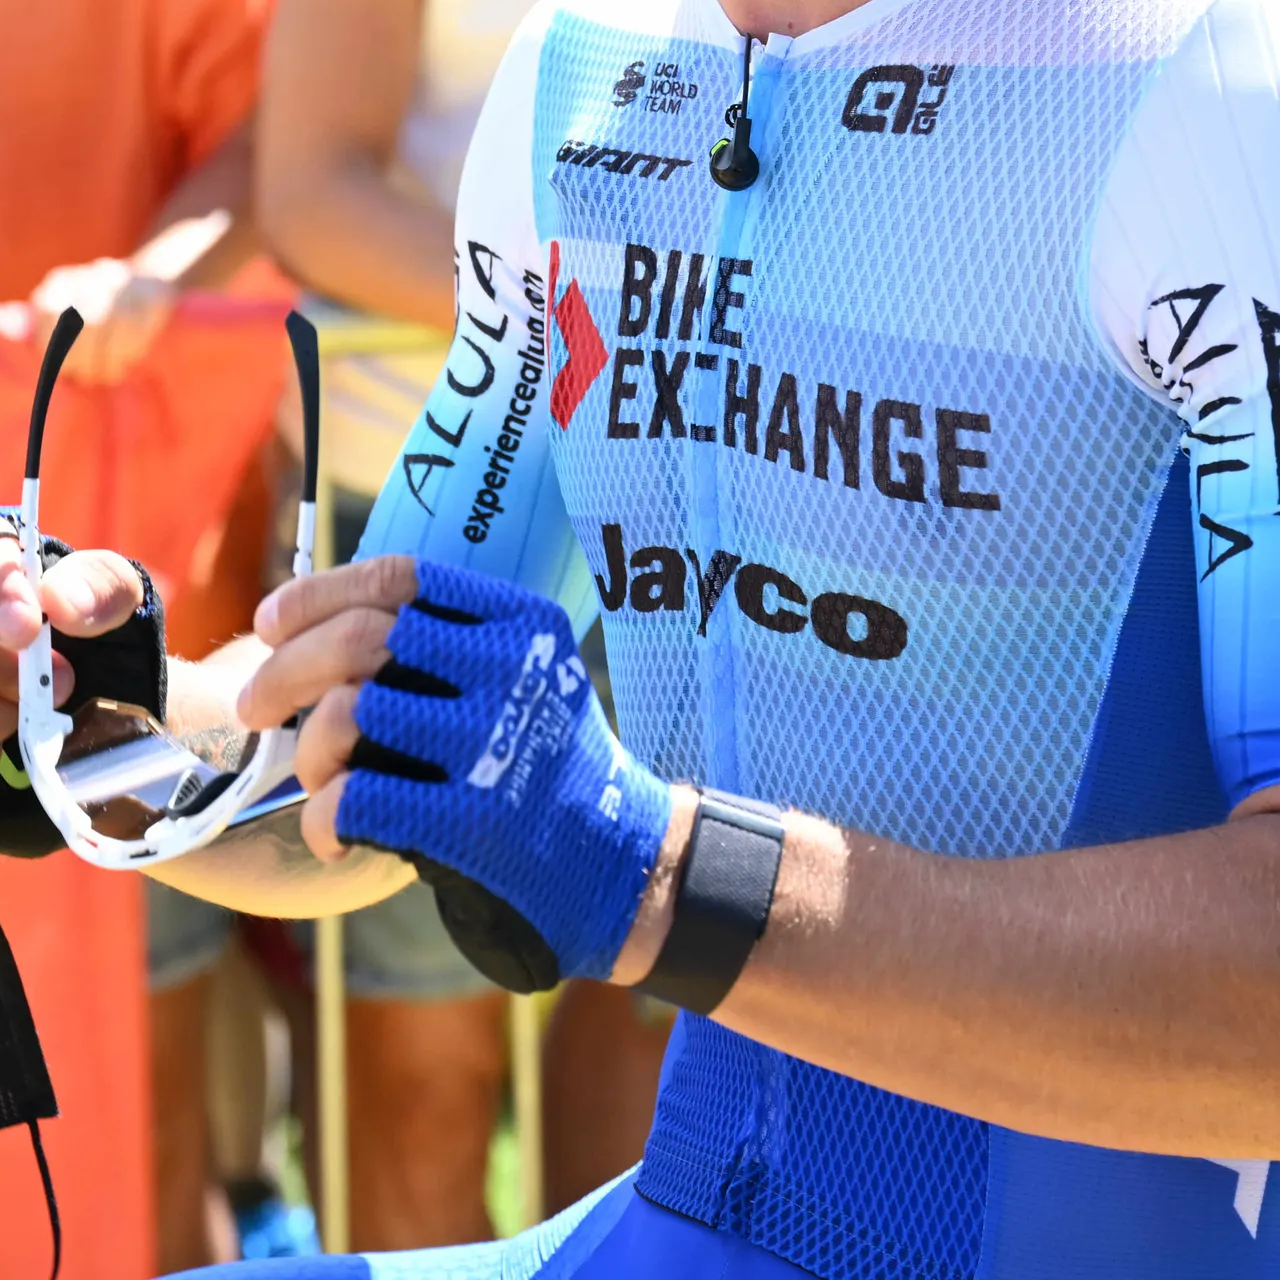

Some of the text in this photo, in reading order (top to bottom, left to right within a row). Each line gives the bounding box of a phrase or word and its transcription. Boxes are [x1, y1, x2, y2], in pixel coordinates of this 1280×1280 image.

[649, 79, 699, 99] WORLD
[654, 62, 680, 78] UCI
[644, 96, 683, 115] TEAM
[556, 139, 694, 181] GIANT
[617, 242, 754, 349] BIKE
[403, 240, 510, 518] ALULA
[595, 524, 908, 661] Jayco
